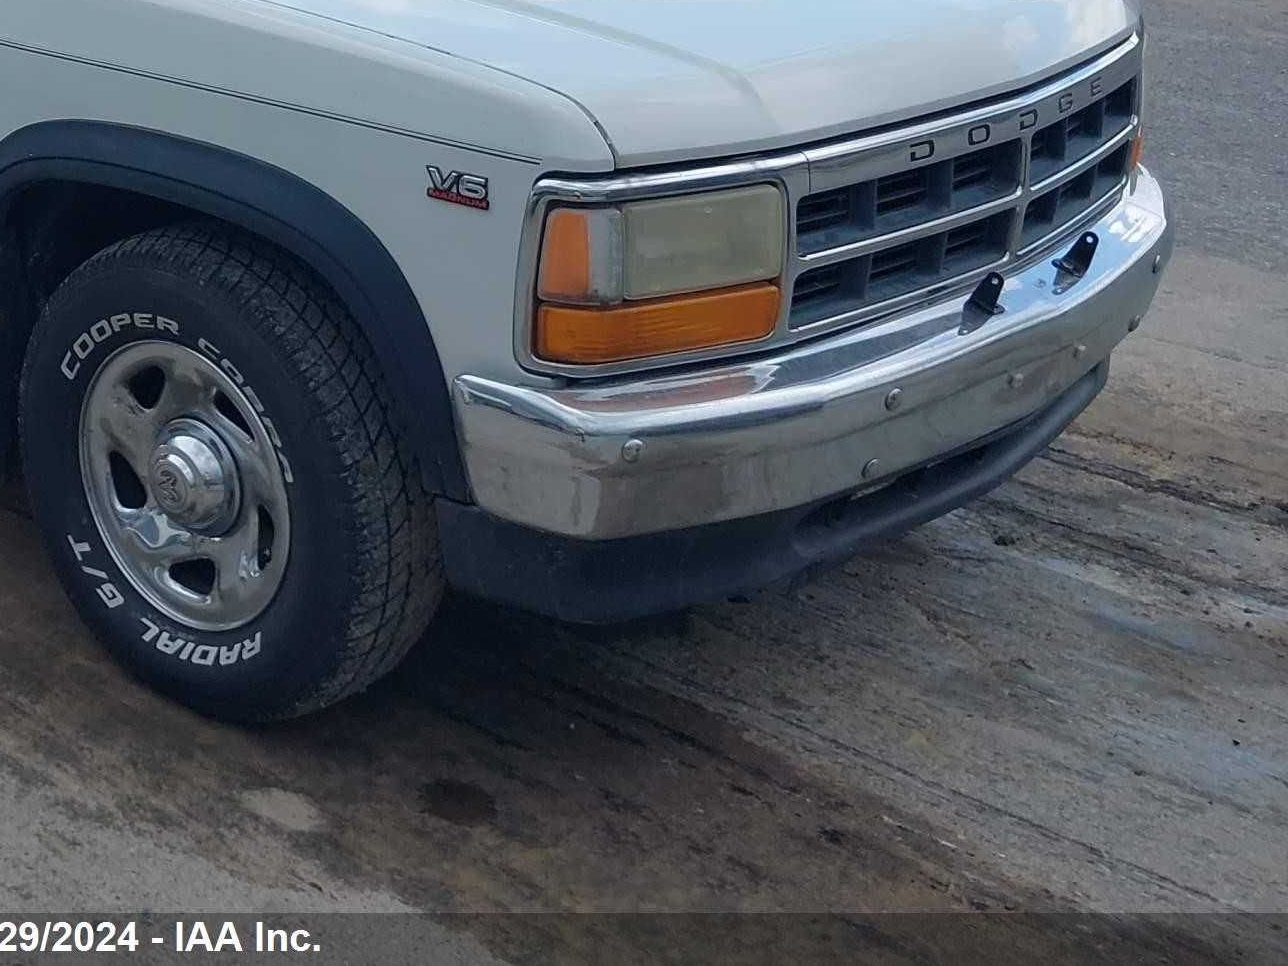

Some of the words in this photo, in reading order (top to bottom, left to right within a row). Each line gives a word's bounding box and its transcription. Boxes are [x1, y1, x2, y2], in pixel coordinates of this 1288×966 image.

[910, 76, 1103, 163] DODGE
[426, 165, 488, 200] V6
[428, 188, 489, 210] MAGNUM
[60, 313, 180, 380] COOPER
[67, 535, 125, 609] G/T
[140, 617, 262, 666] RADIAL
